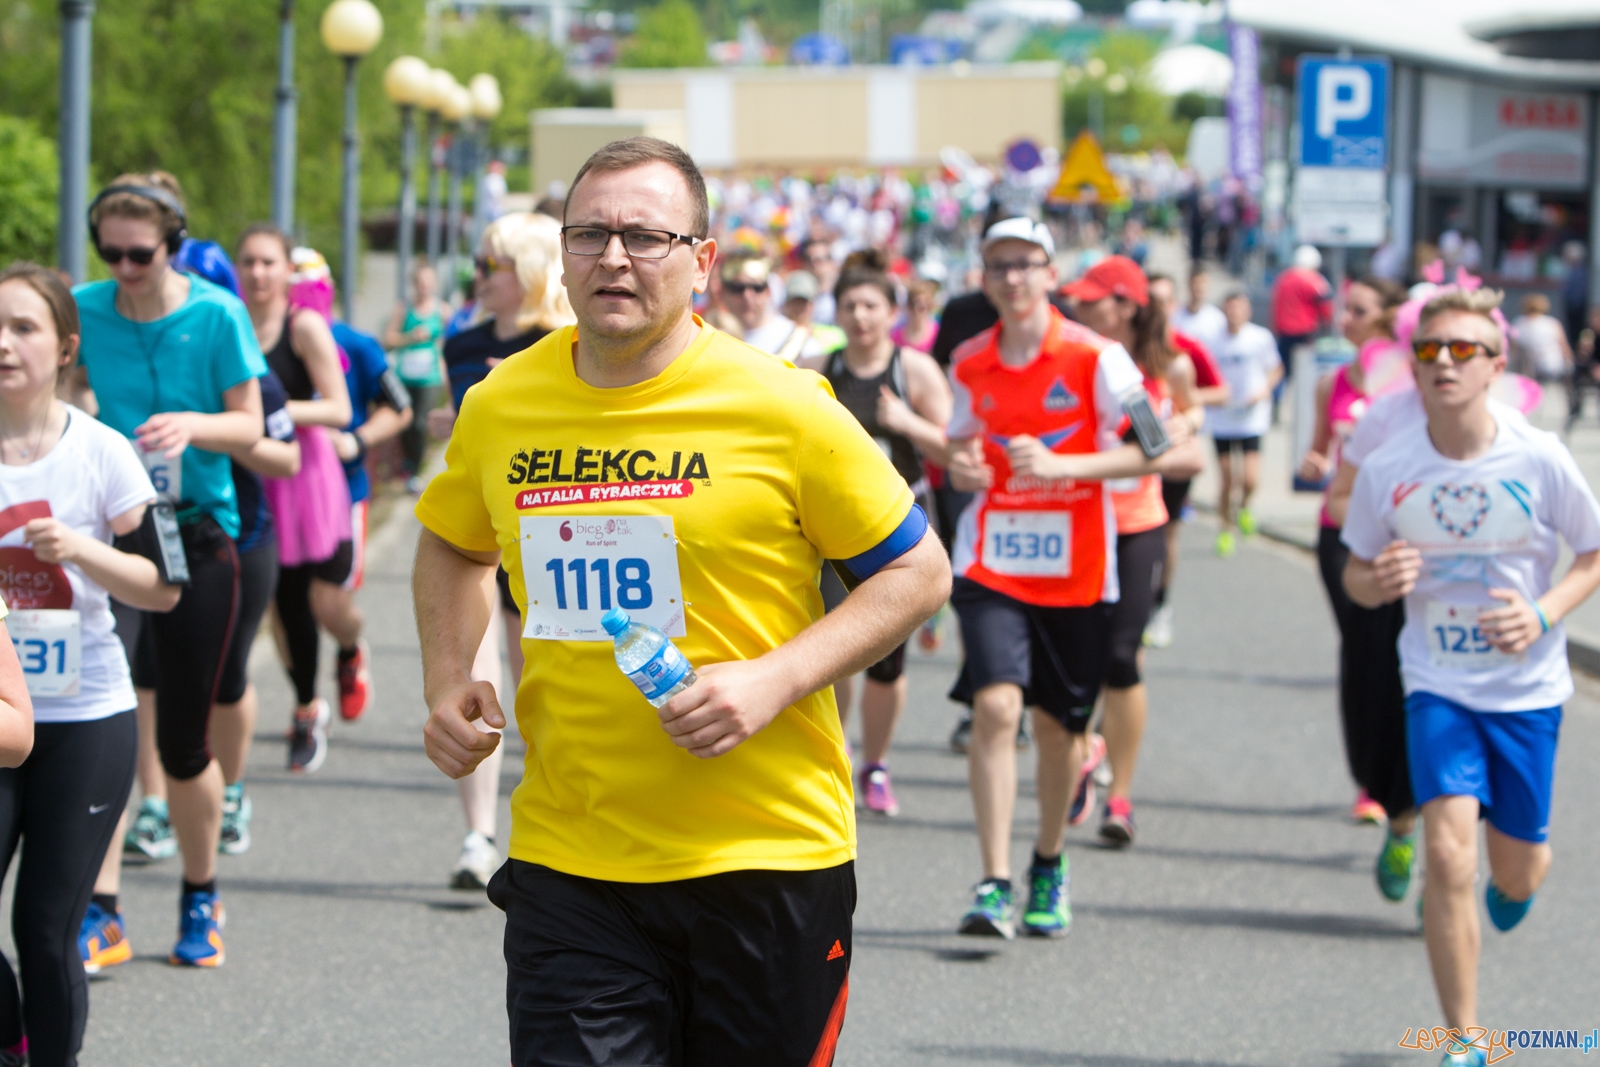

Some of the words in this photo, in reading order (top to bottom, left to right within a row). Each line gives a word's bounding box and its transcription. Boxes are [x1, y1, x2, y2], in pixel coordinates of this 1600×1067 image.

[507, 445, 710, 485] SELEKCJA
[522, 488, 584, 506] NATALIA
[589, 482, 684, 501] RYBARCZYK
[576, 519, 604, 540] bieg
[617, 526, 632, 535] tak
[993, 532, 1063, 560] 1530
[545, 557, 653, 610] 1118
[1434, 624, 1500, 653] 125
[10, 638, 66, 675] 31
